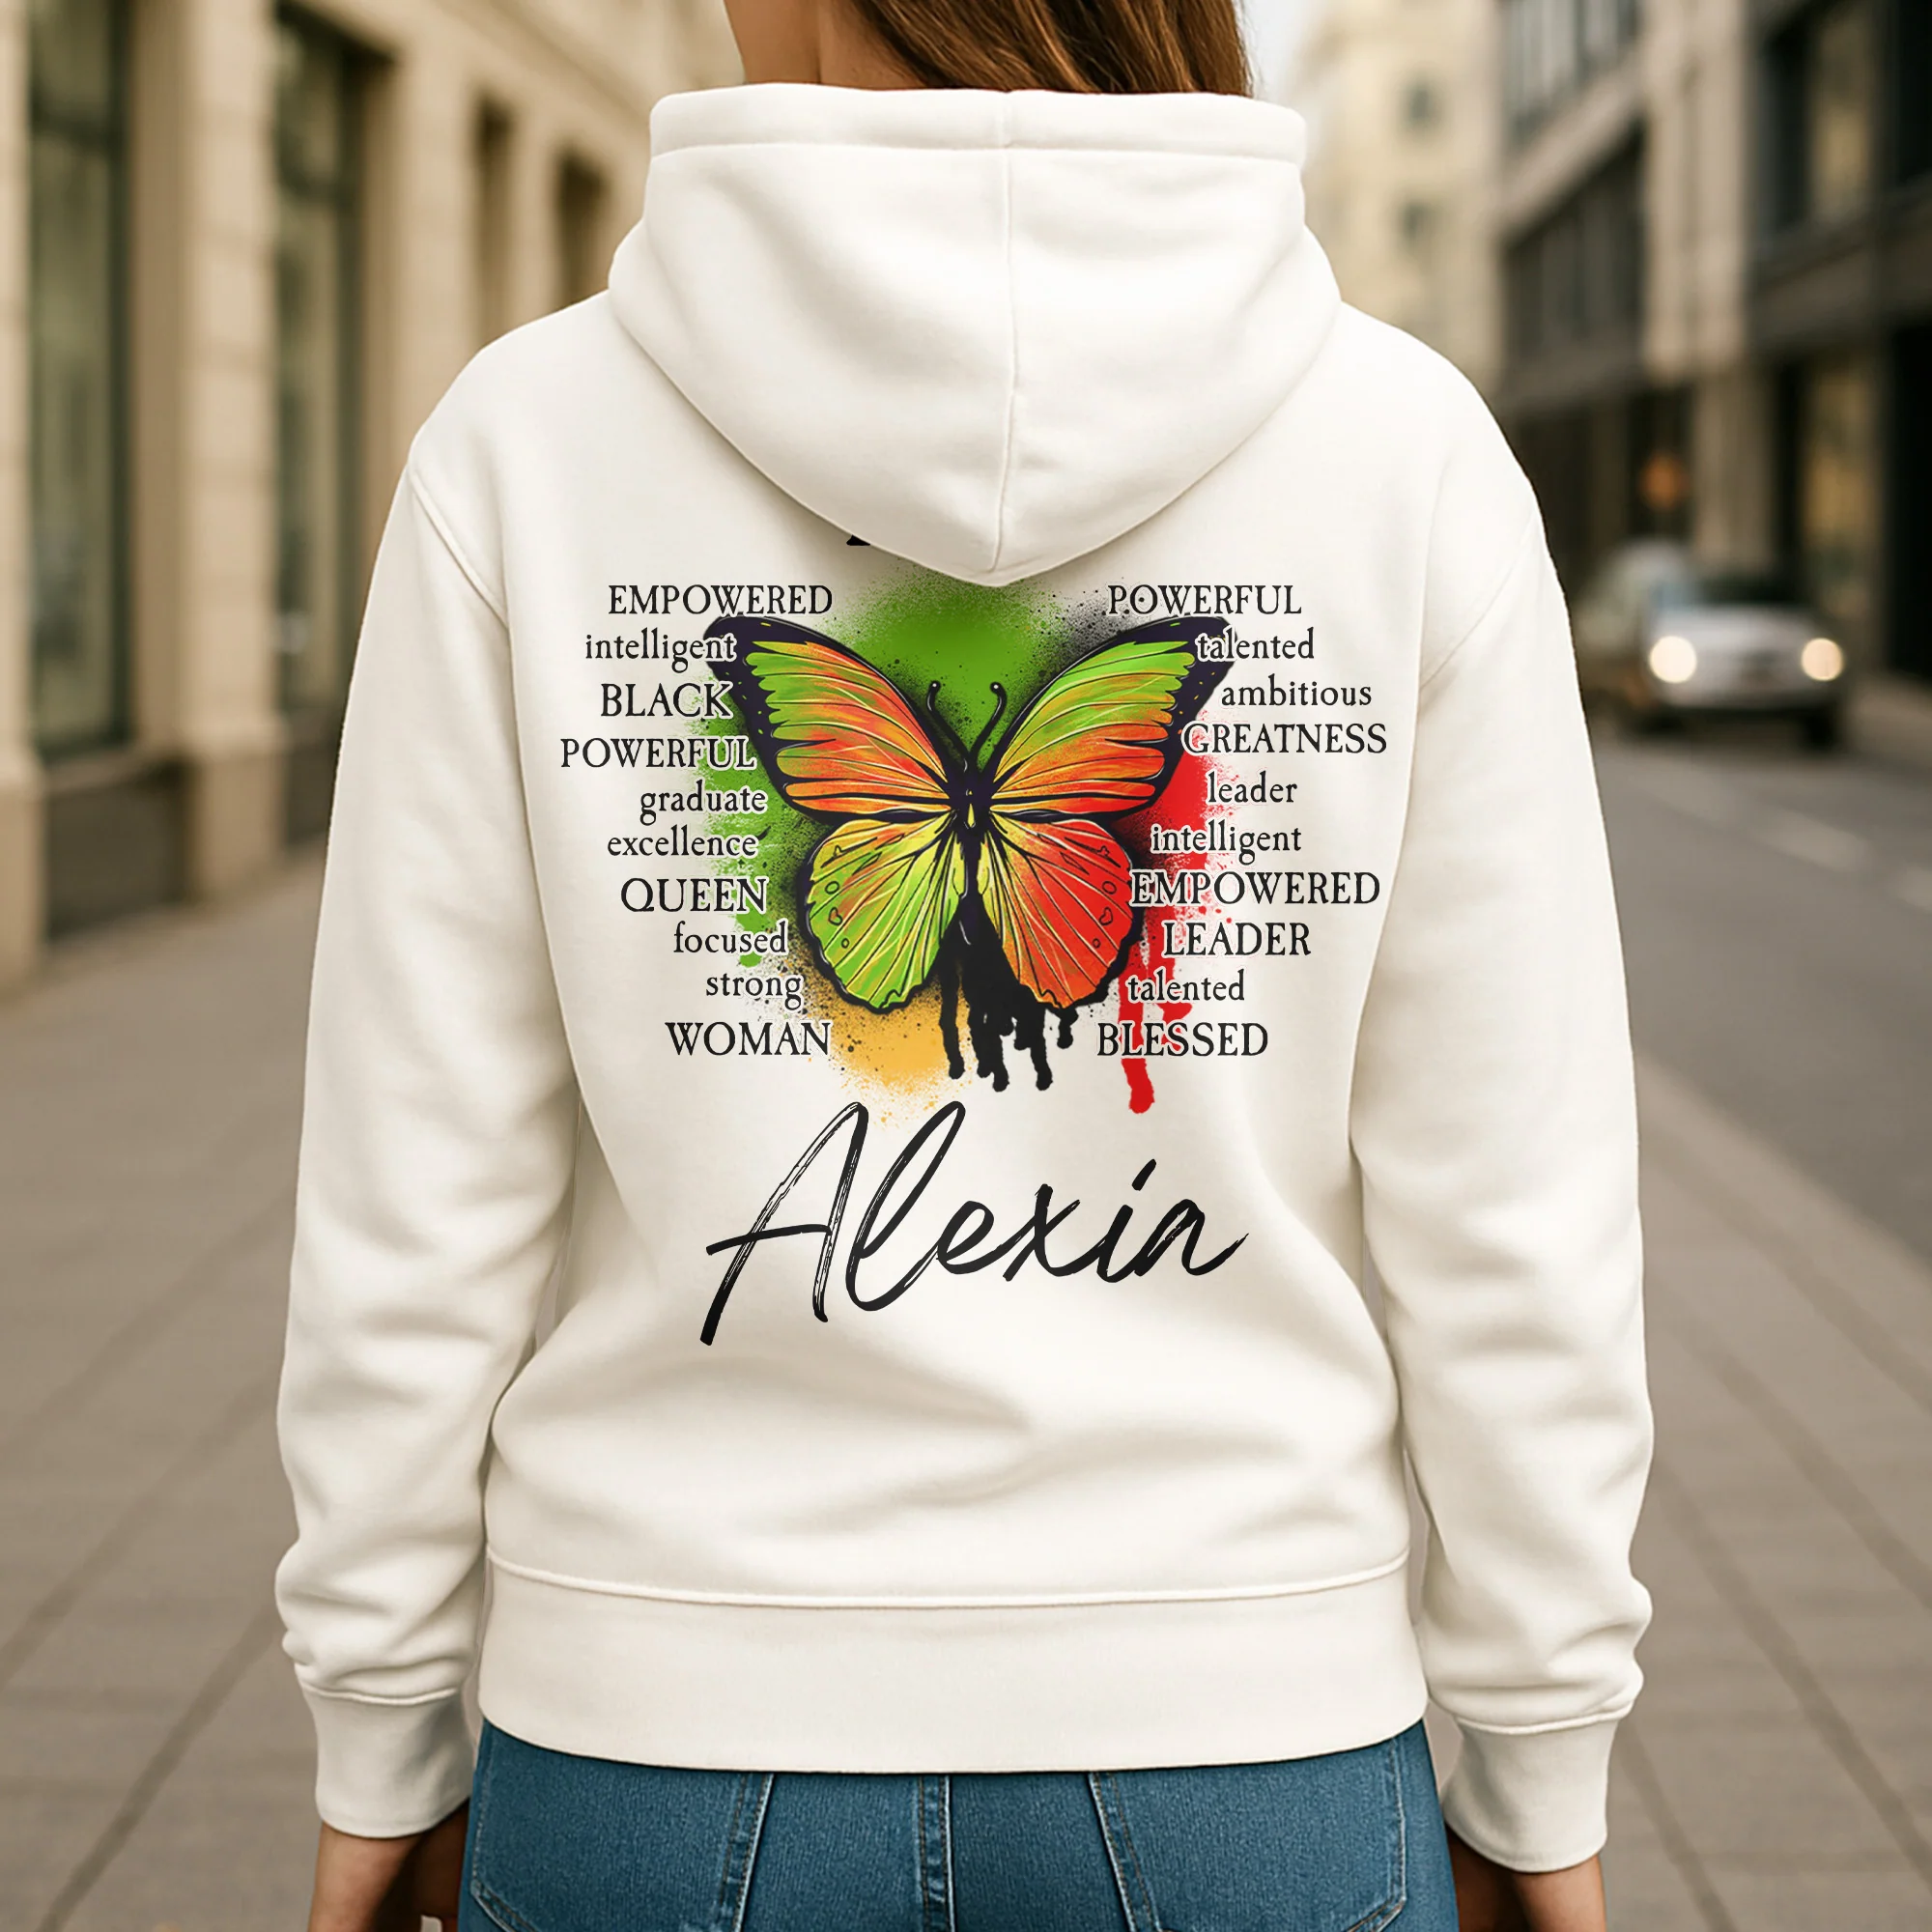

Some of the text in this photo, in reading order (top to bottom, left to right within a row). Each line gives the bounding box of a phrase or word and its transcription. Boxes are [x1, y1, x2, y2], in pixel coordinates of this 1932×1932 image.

[608, 584, 834, 615] EMPOWERED
[1107, 583, 1302, 615] POWERFUL
[585, 627, 735, 673] intelligent
[1197, 626, 1316, 660] talented
[600, 682, 734, 718] BLACK
[1221, 673, 1373, 707] ambitious
[560, 737, 755, 768] POWERFUL
[1182, 723, 1388, 754] GREATNESS
[639, 779, 767, 826] graduate
[1208, 770, 1298, 804] leader
[607, 824, 757, 857] excellence
[1151, 818, 1302, 866] intelligent
[620, 877, 767, 913] QUEEN
[1129, 870, 1381, 905] EMPOWERED
[672, 920, 787, 954] focused
[1162, 922, 1312, 956] LEADER
[705, 973, 803, 1010] strong
[1127, 968, 1246, 1001] talented
[664, 1021, 832, 1057] WOMAN
[1096, 1021, 1269, 1057] BLESSED
[699, 1100, 1249, 1346] Alexia
